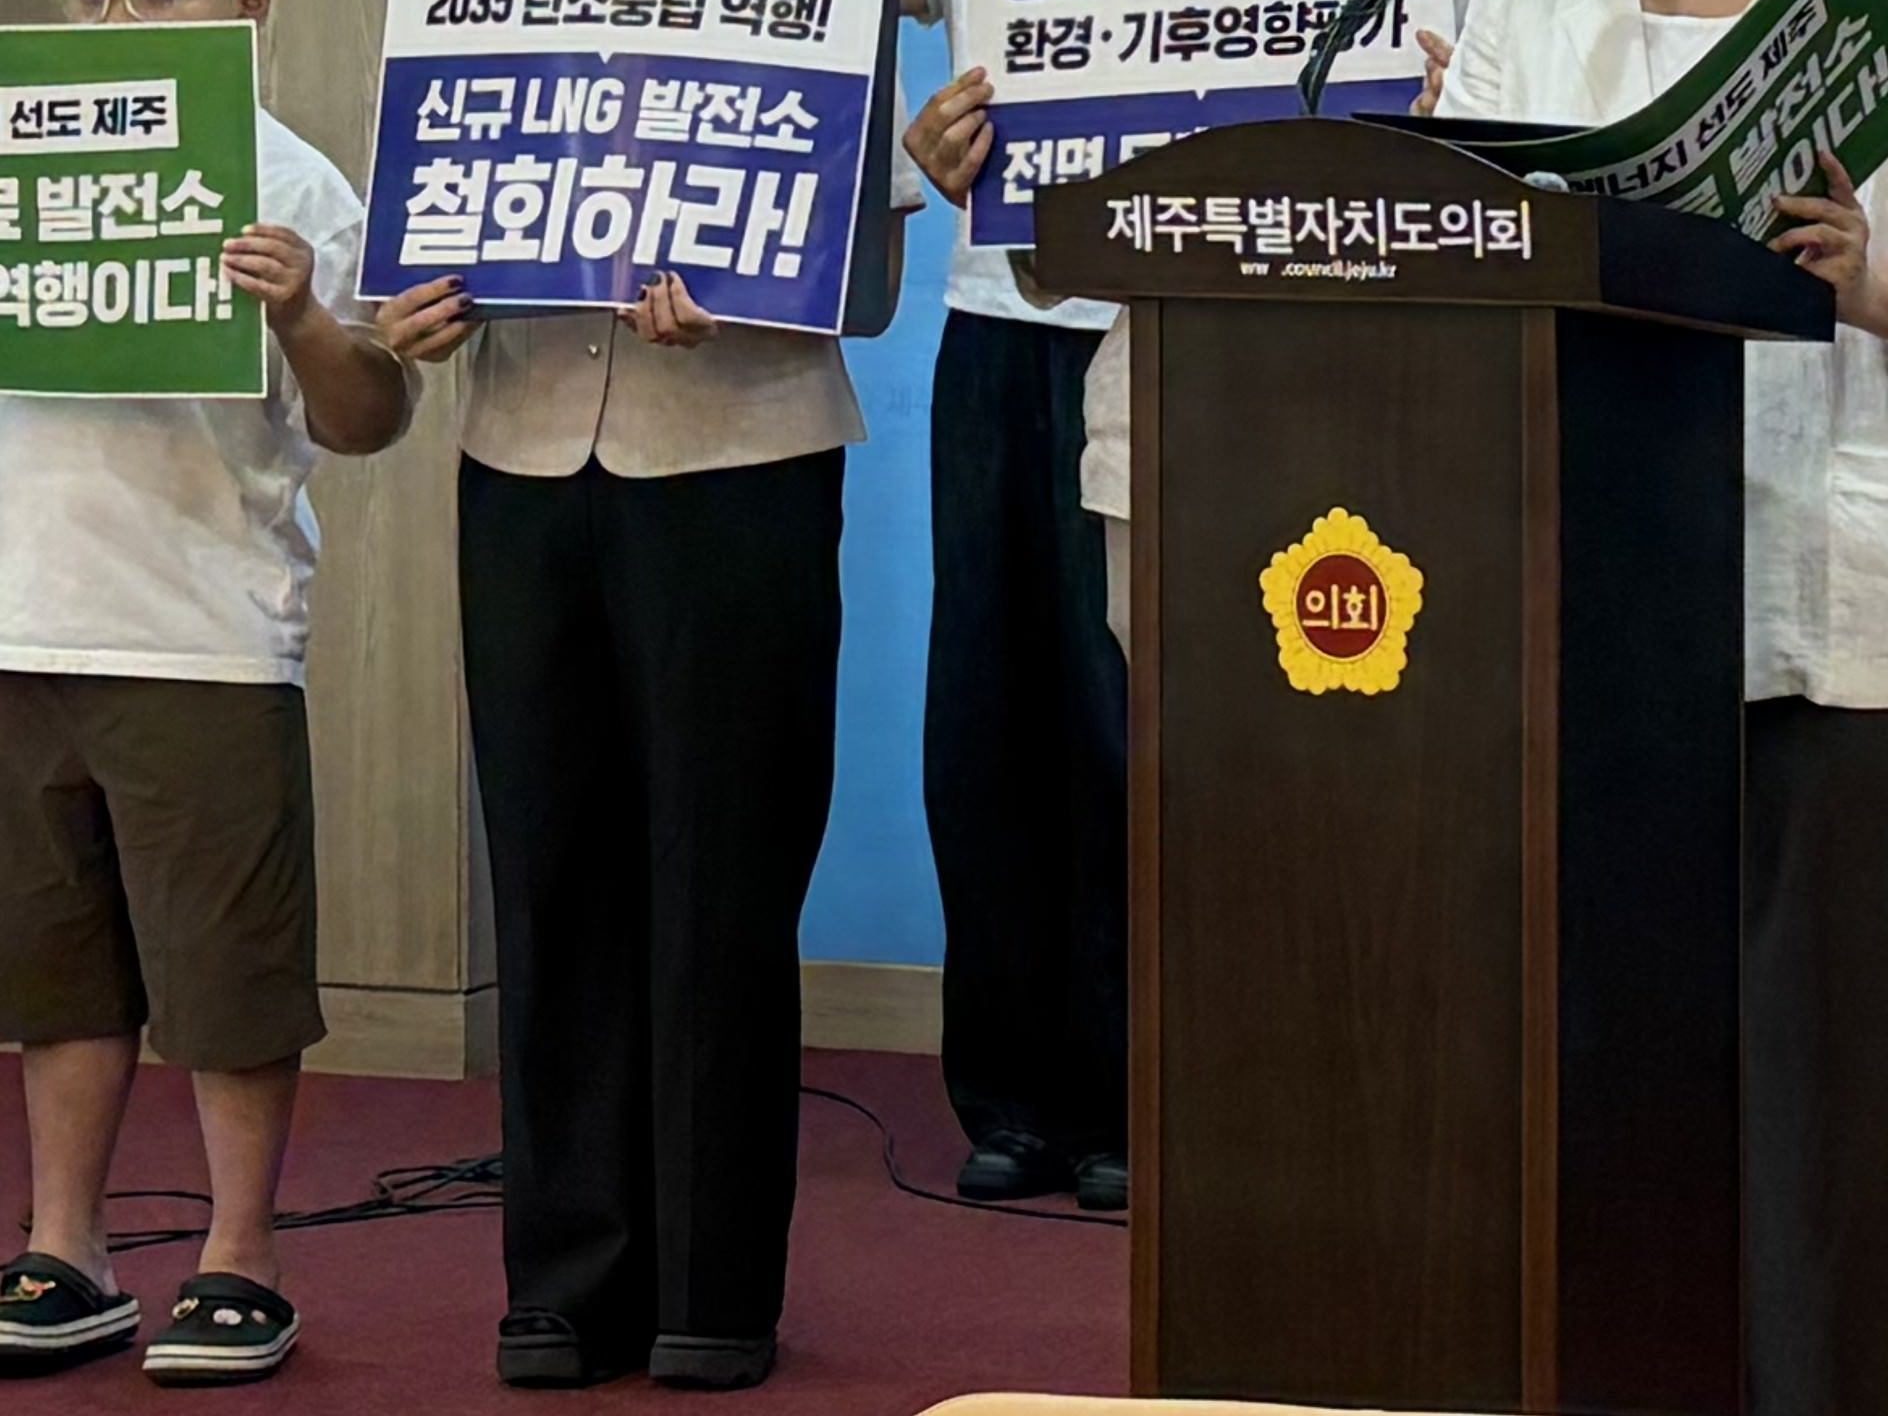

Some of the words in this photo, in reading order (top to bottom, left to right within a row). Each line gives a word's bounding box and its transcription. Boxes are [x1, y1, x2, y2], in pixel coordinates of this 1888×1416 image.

[10, 98, 82, 139] 선도
[92, 95, 167, 137] 제주
[415, 77, 517, 142] 신규
[520, 77, 625, 134] LNG
[634, 78, 819, 152] 발전소
[1696, 70, 1757, 153] 선도
[1729, 14, 1872, 196] 발전소
[37, 169, 224, 242] 발전소
[399, 155, 819, 278] 철회하라!
[1107, 194, 1532, 259] 제주특별자치도의회
[0, 256, 232, 327] 역행이다!
[1302, 584, 1378, 631] 의회
